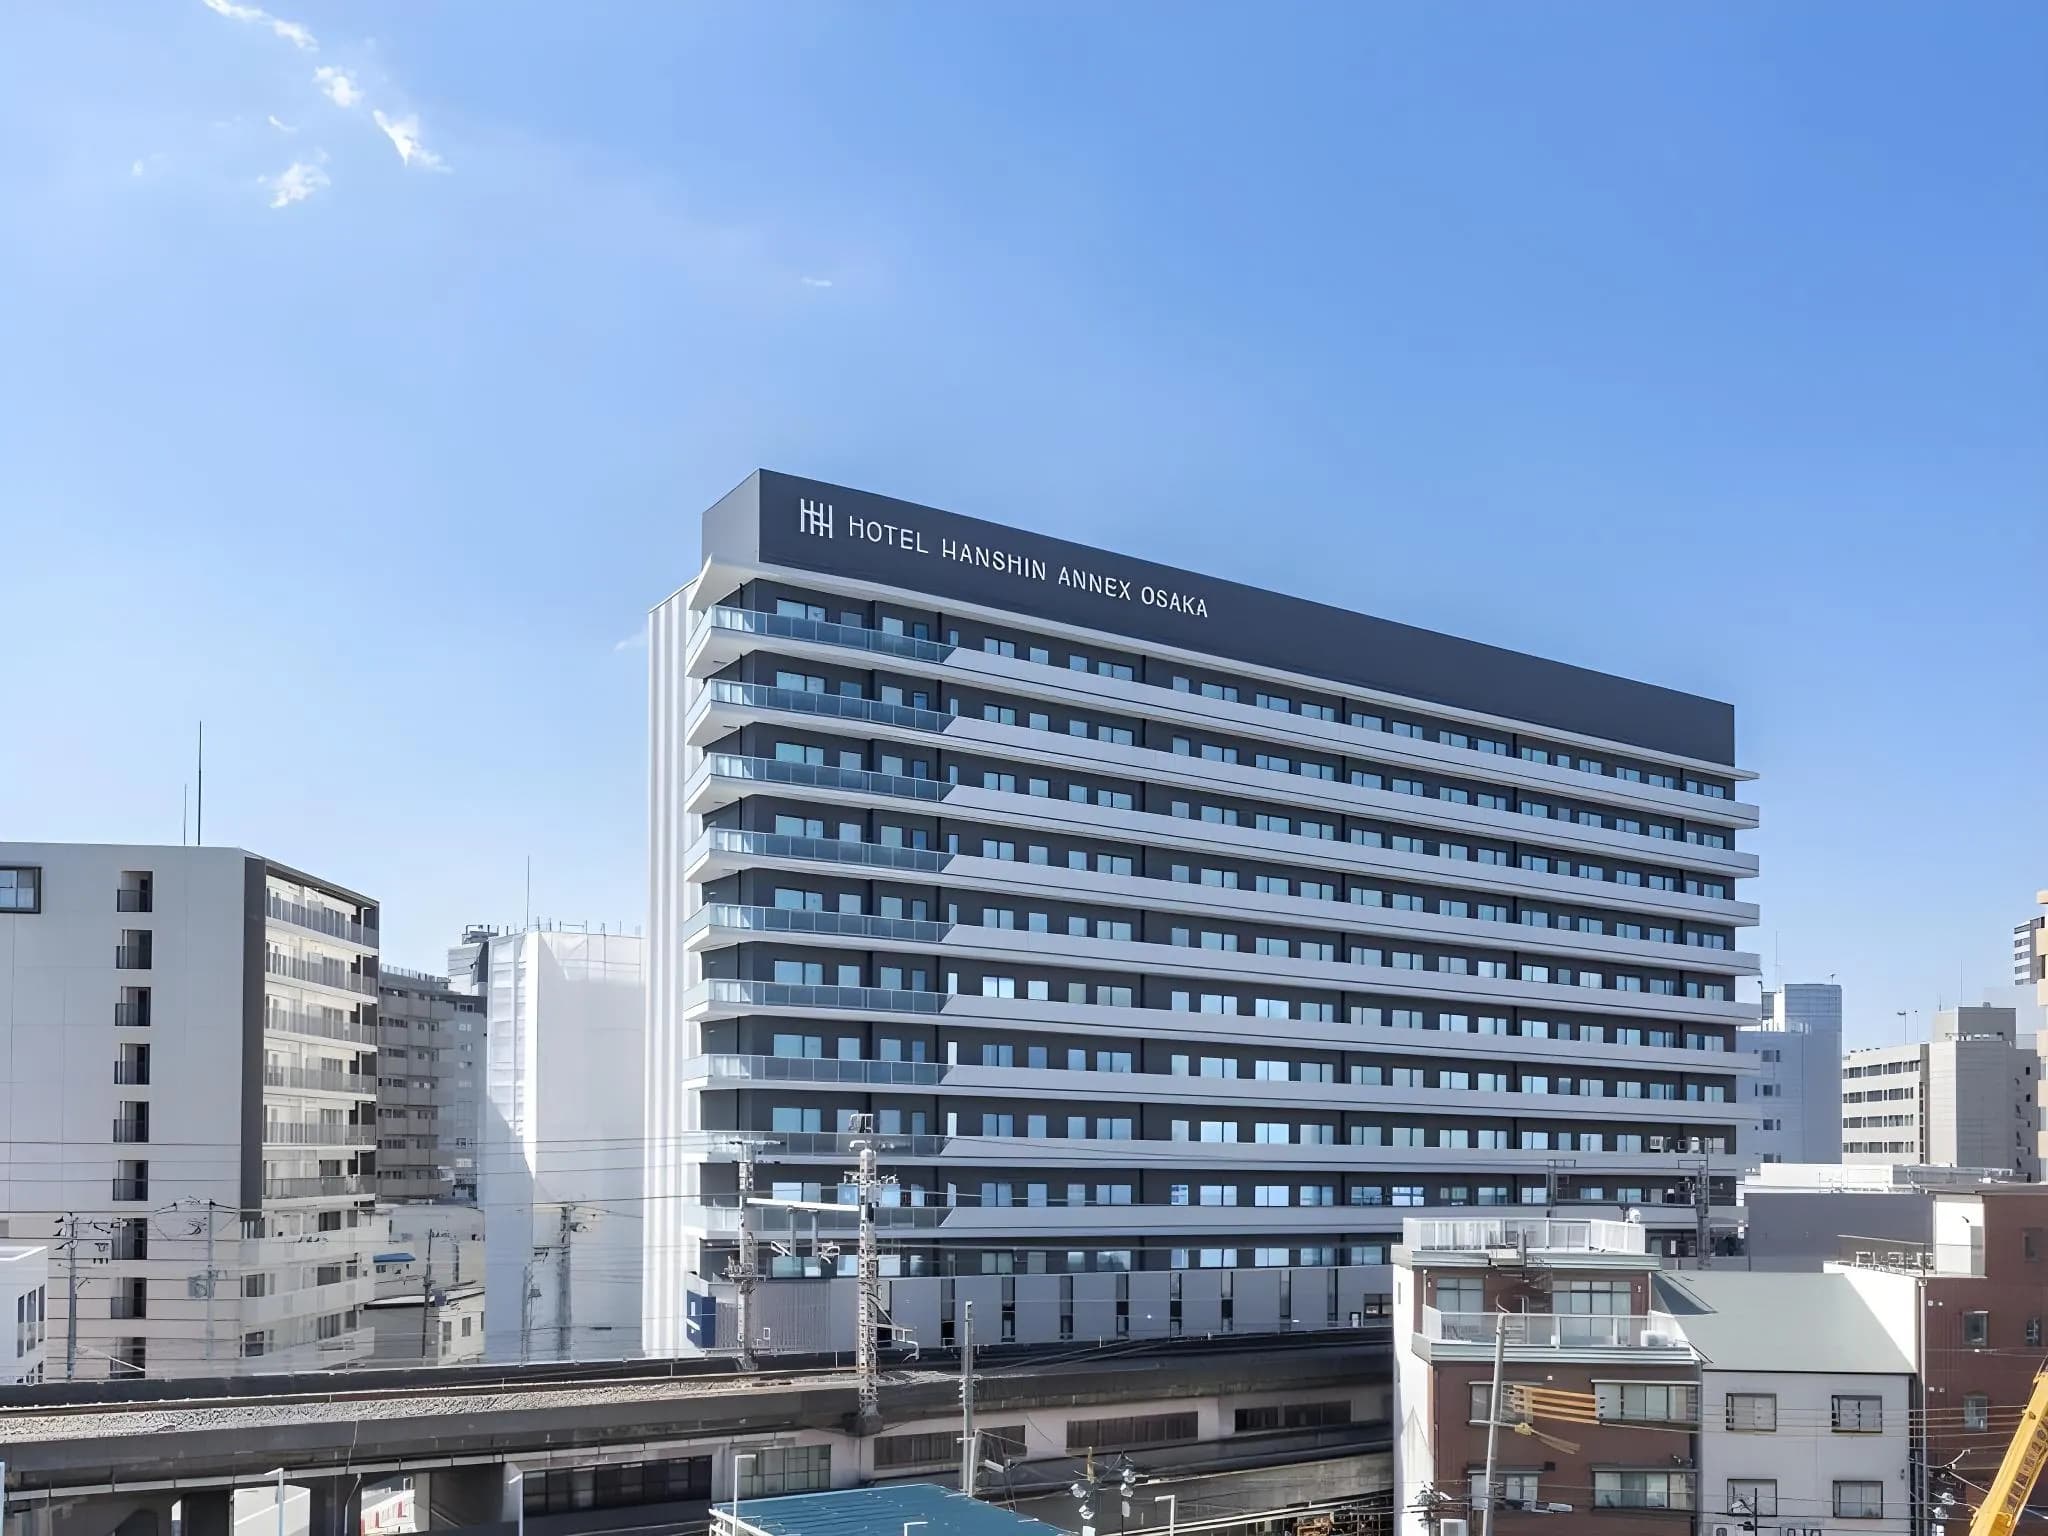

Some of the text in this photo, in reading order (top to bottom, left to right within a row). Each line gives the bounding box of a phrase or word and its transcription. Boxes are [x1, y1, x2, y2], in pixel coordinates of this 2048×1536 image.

[849, 515, 1208, 618] HOTEL HANSHIN ANNEX OSAKA
